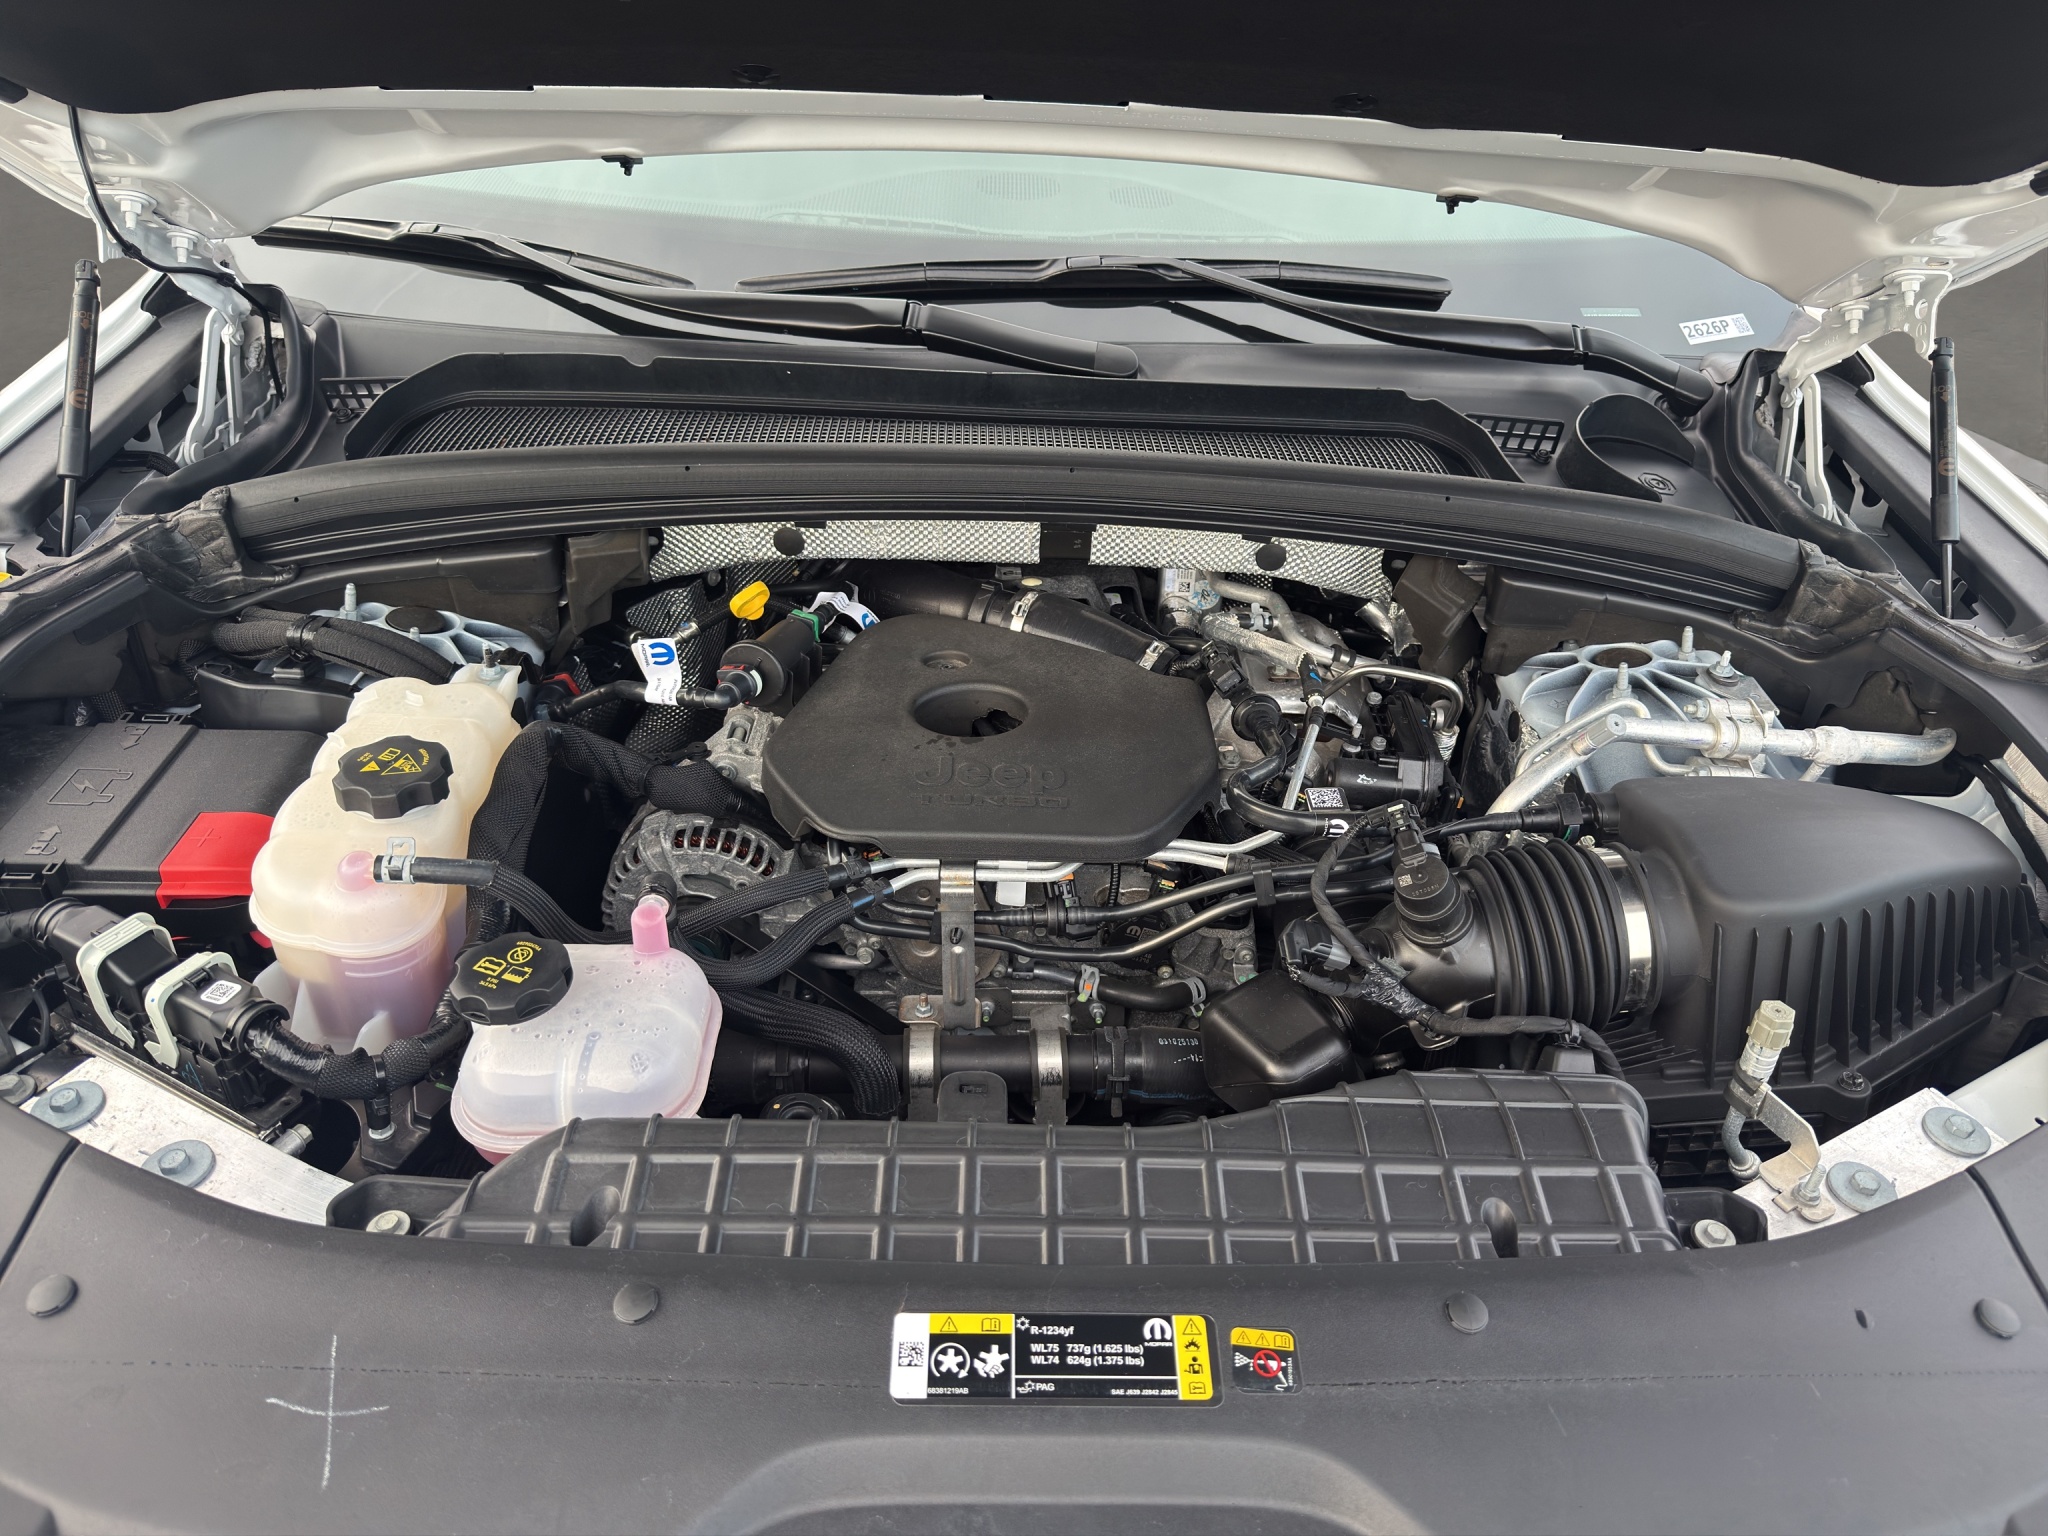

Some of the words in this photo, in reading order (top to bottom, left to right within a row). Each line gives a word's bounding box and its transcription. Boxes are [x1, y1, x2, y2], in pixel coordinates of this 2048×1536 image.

[1683, 319, 1729, 338] 2626P
[914, 752, 1067, 796] Jeep
[909, 793, 1070, 809] TURBO
[1030, 1326, 1075, 1337] R-1234yf
[1030, 1344, 1060, 1353] WL75
[1066, 1344, 1092, 1354] 737g
[1093, 1343, 1123, 1354] (1.625
[1124, 1344, 1144, 1355] lbs)
[1030, 1355, 1060, 1364] WL74
[1066, 1356, 1092, 1367] 624g
[1093, 1355, 1124, 1367] (1.375
[1124, 1356, 1145, 1367] lbs)
[927, 1387, 969, 1395] 68381219AB
[1035, 1382, 1056, 1391] PAG
